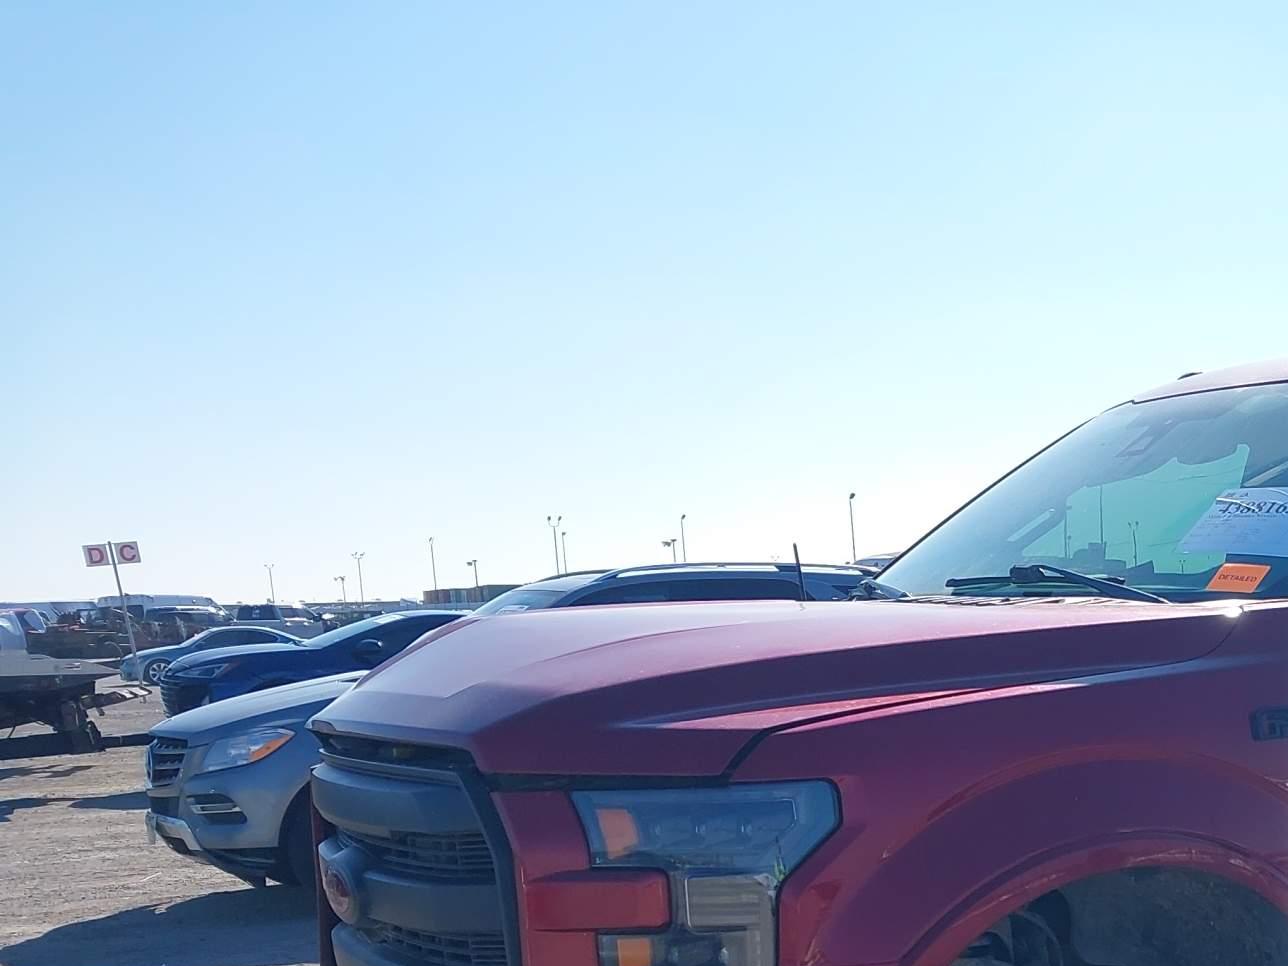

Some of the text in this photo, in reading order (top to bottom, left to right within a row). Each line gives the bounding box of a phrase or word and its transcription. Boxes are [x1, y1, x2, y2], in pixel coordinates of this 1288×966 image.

[87, 547, 105, 564] D
[119, 544, 137, 562] C
[1217, 574, 1259, 582] DETAILED
